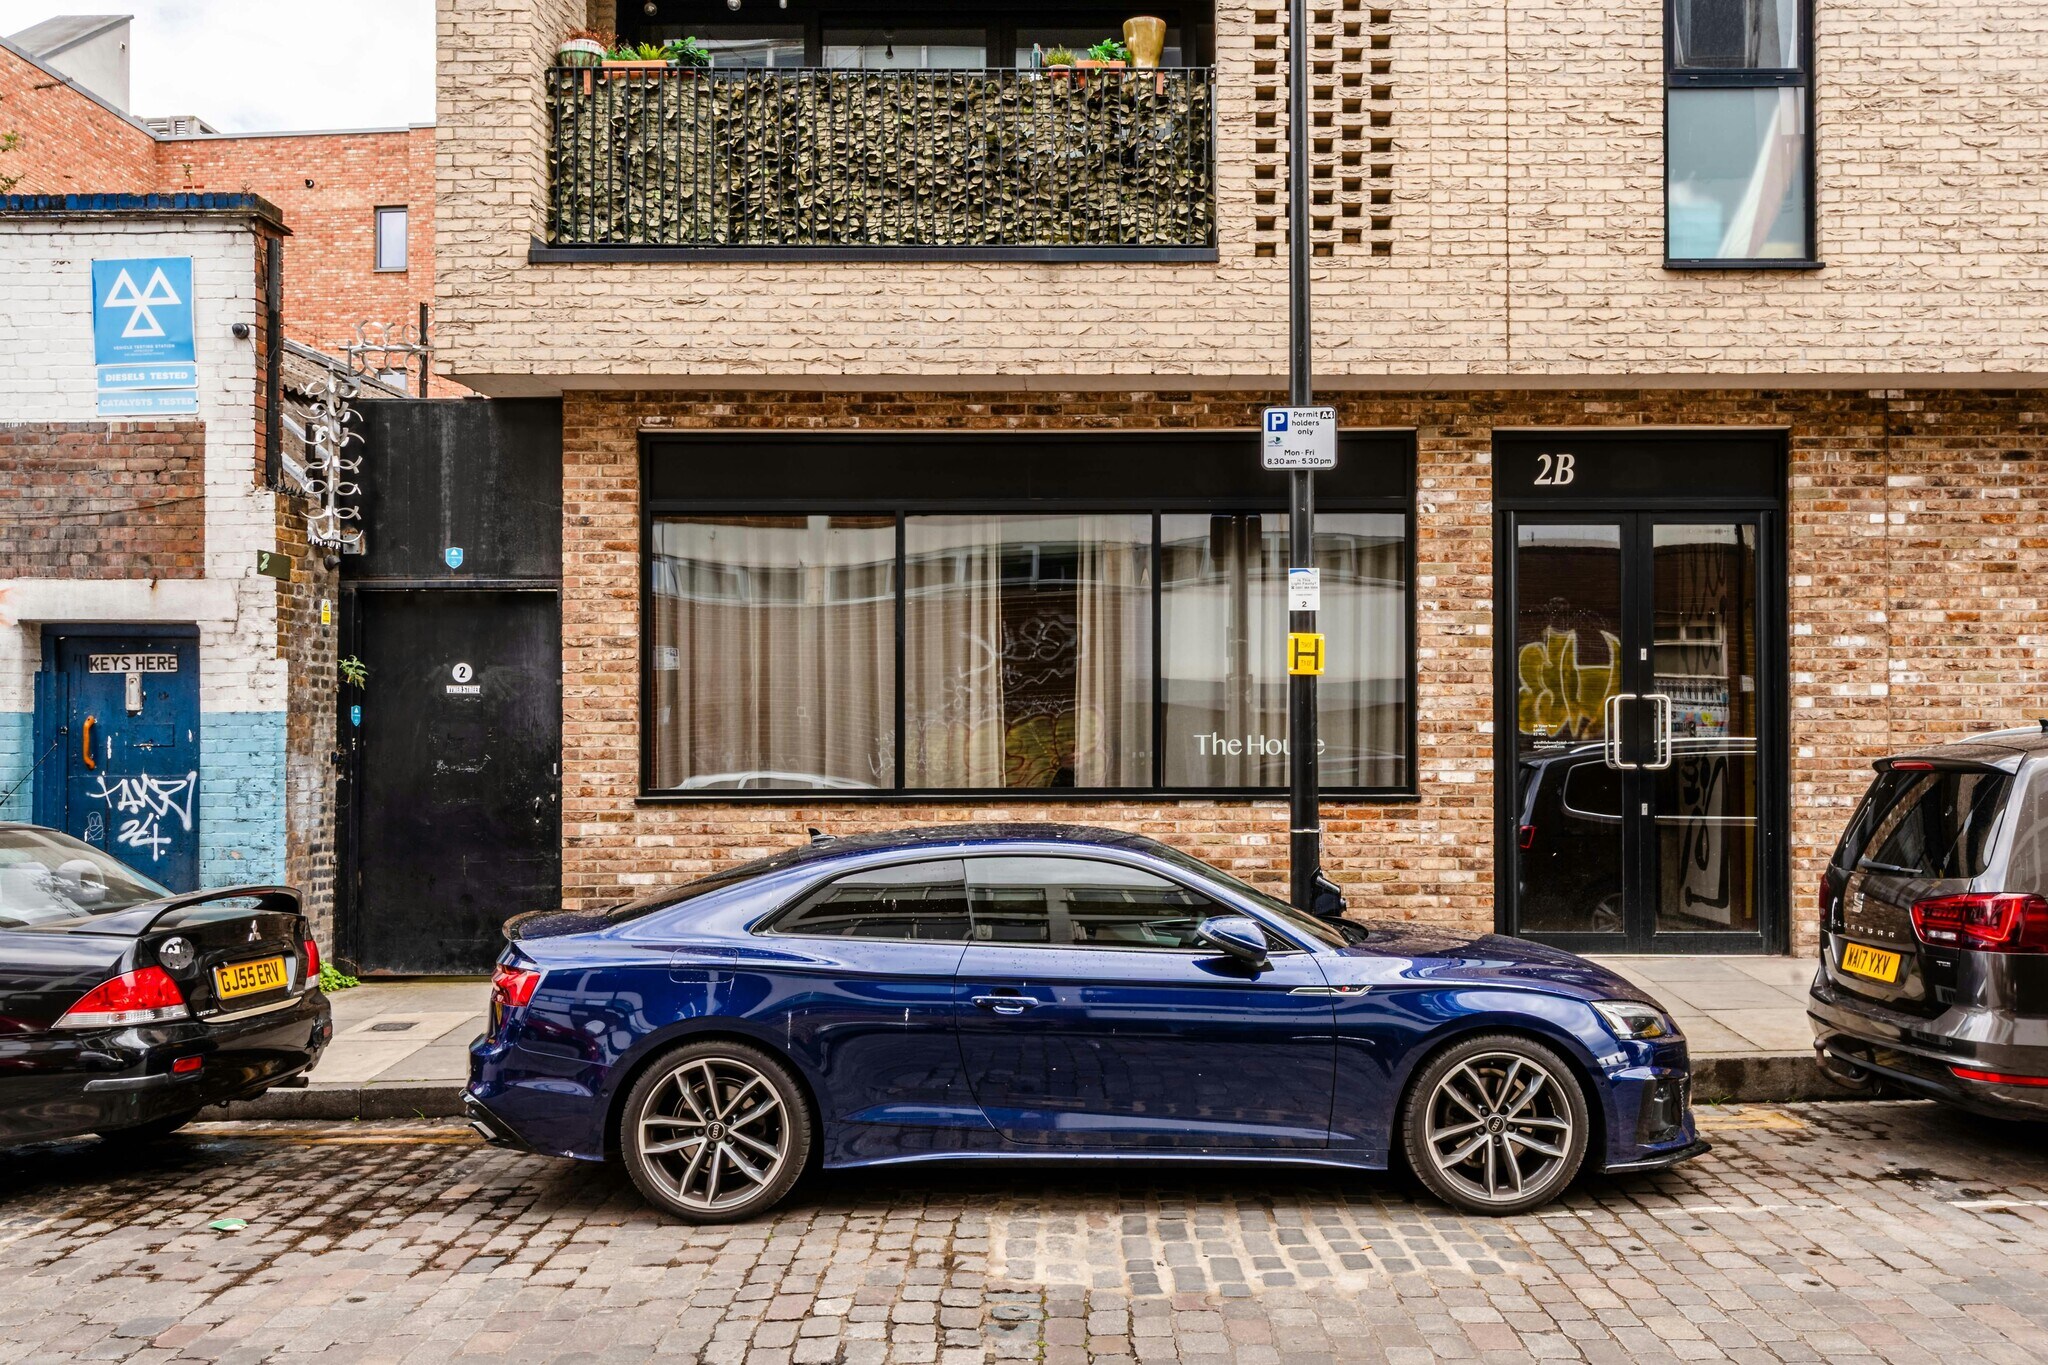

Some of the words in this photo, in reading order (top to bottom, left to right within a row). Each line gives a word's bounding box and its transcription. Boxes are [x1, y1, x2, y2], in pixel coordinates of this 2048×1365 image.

[105, 372, 145, 382] DIESELS
[150, 371, 188, 380] TESTED
[101, 398, 153, 407] CATALYSTS
[158, 397, 194, 406] TESTED
[1271, 413, 1285, 430] P
[1321, 411, 1334, 419] A4
[1297, 428, 1314, 436] only
[1533, 453, 1575, 485] 2B
[259, 552, 270, 572] 2
[1301, 600, 1307, 608] 2
[1293, 638, 1319, 671] H
[90, 656, 131, 671] KEYS
[136, 655, 178, 670] HERE
[459, 666, 466, 678] 2
[1193, 732, 1243, 756] The
[1247, 734, 1326, 756] Houe
[1847, 947, 1869, 969] WA17
[1868, 952, 1891, 976] YXV
[220, 966, 256, 993] GJ55
[256, 961, 280, 985] ERV
